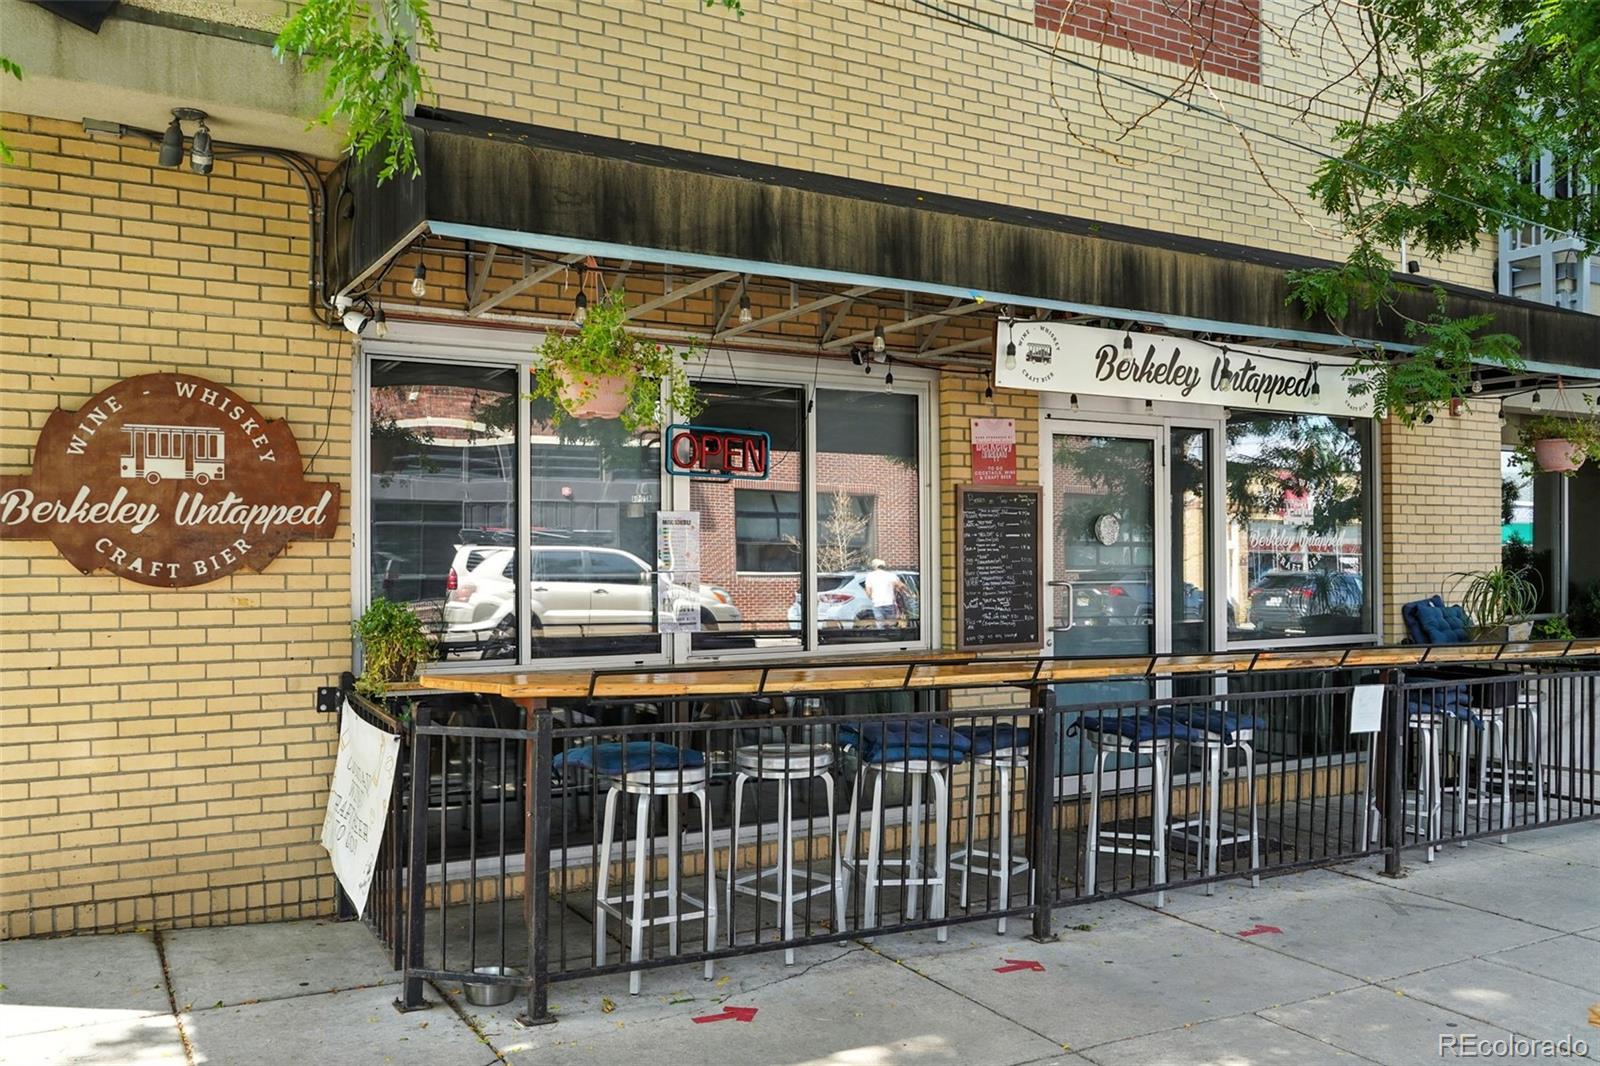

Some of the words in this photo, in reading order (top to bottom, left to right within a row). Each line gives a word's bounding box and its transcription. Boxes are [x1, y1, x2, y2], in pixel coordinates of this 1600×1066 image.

[1018, 328, 1030, 346] WINE
[1040, 325, 1061, 351] WHISKEY
[1022, 368, 1040, 383] CRAFT
[1041, 371, 1055, 383] BIER
[1095, 344, 1201, 397] Berkeley
[1210, 356, 1313, 403] Untapped
[66, 396, 123, 456] WINE
[174, 381, 276, 464] WHISKEY
[671, 432, 766, 473] OPEN
[0, 484, 160, 534] Berkeley
[175, 489, 333, 534] Untapped
[94, 538, 181, 579] CRAFT
[192, 538, 253, 577] BIER
